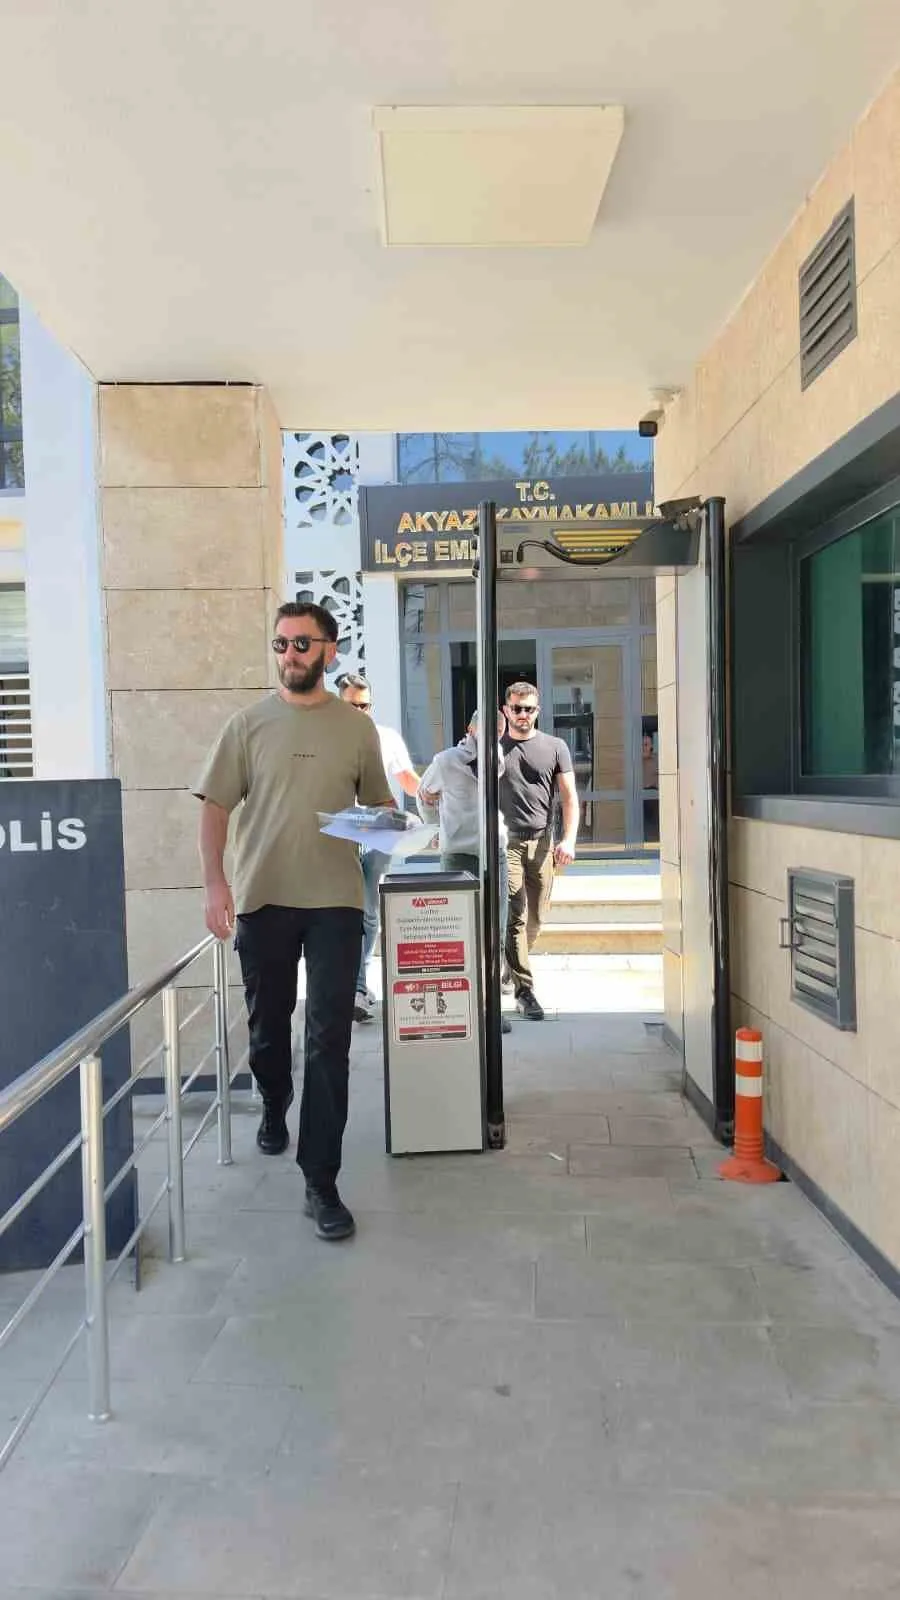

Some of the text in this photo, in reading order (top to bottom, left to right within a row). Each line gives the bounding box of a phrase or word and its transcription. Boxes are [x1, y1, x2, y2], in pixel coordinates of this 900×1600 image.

[515, 481, 557, 502] T.C.
[397, 509, 480, 534] AKYAZ
[0, 811, 87, 852] LİS
